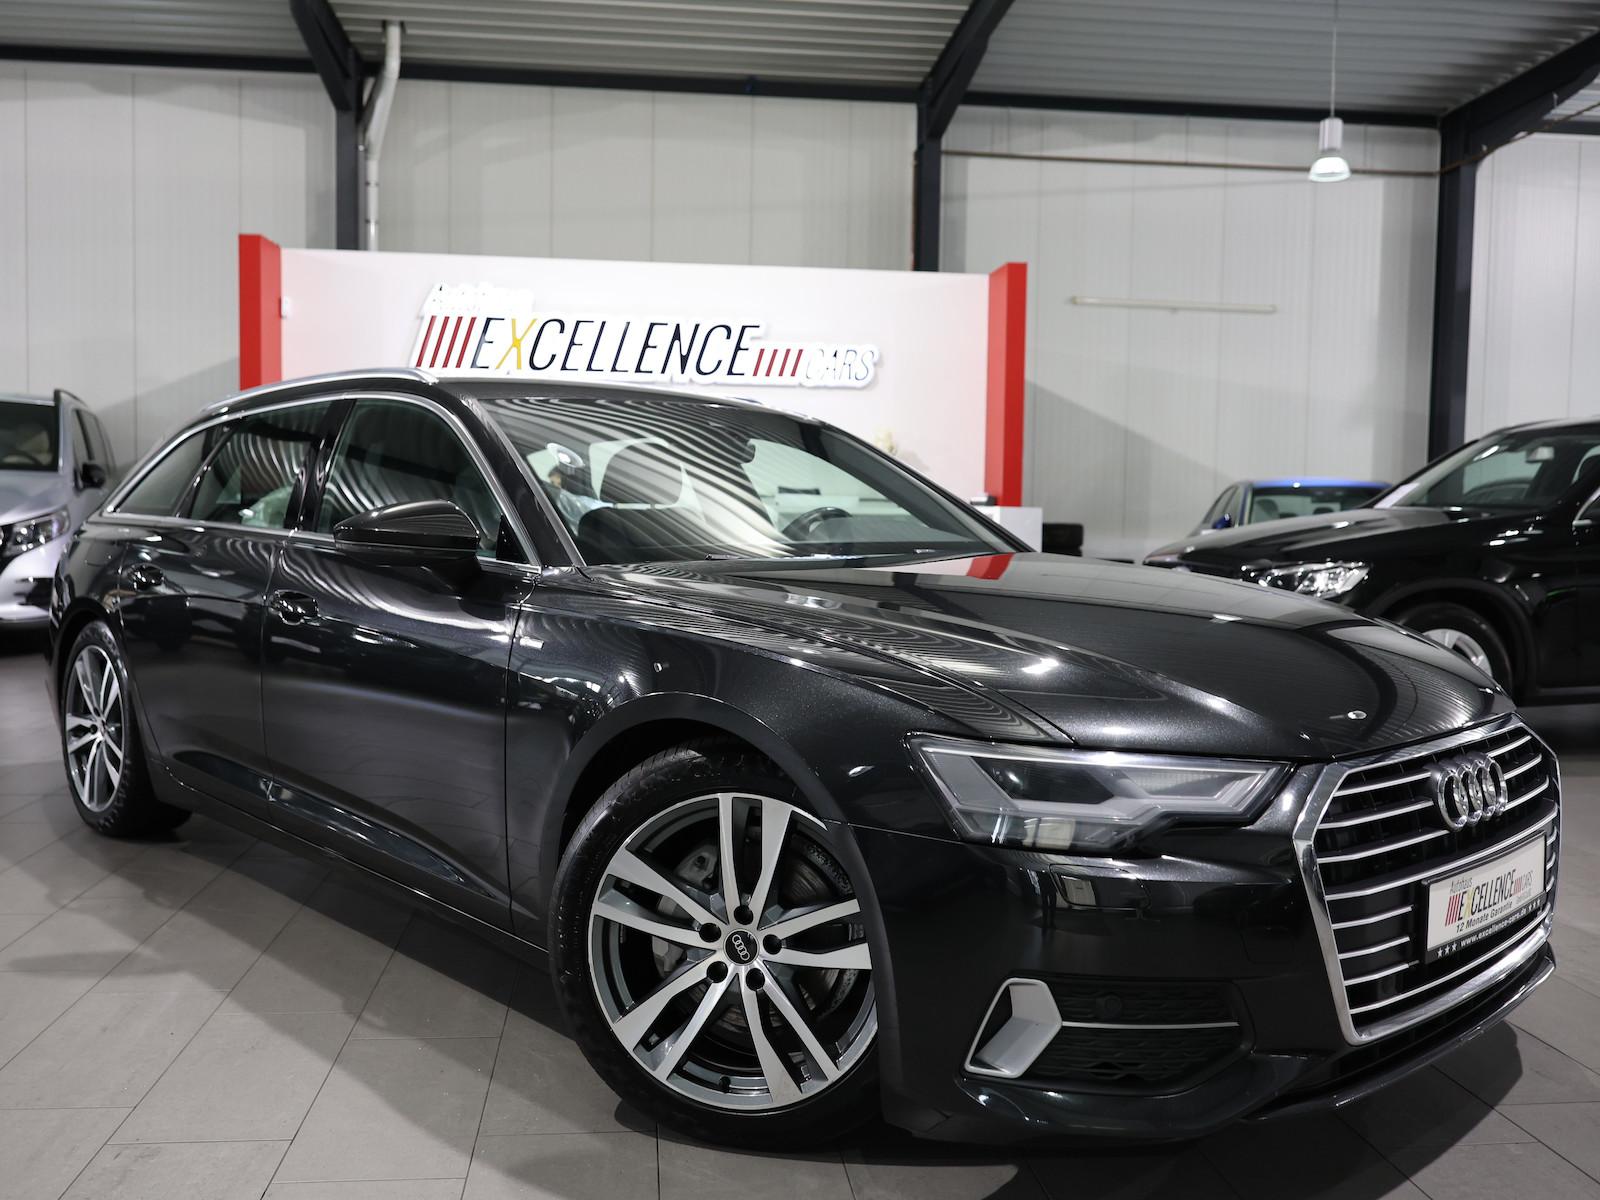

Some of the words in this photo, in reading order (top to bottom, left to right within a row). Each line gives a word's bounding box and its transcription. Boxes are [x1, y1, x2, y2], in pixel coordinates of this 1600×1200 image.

[470, 317, 760, 377] EXCELLENCE
[1457, 868, 1516, 921] EXCELLENCE
[1456, 922, 1465, 933] 12
[1466, 912, 1489, 929] Monate
